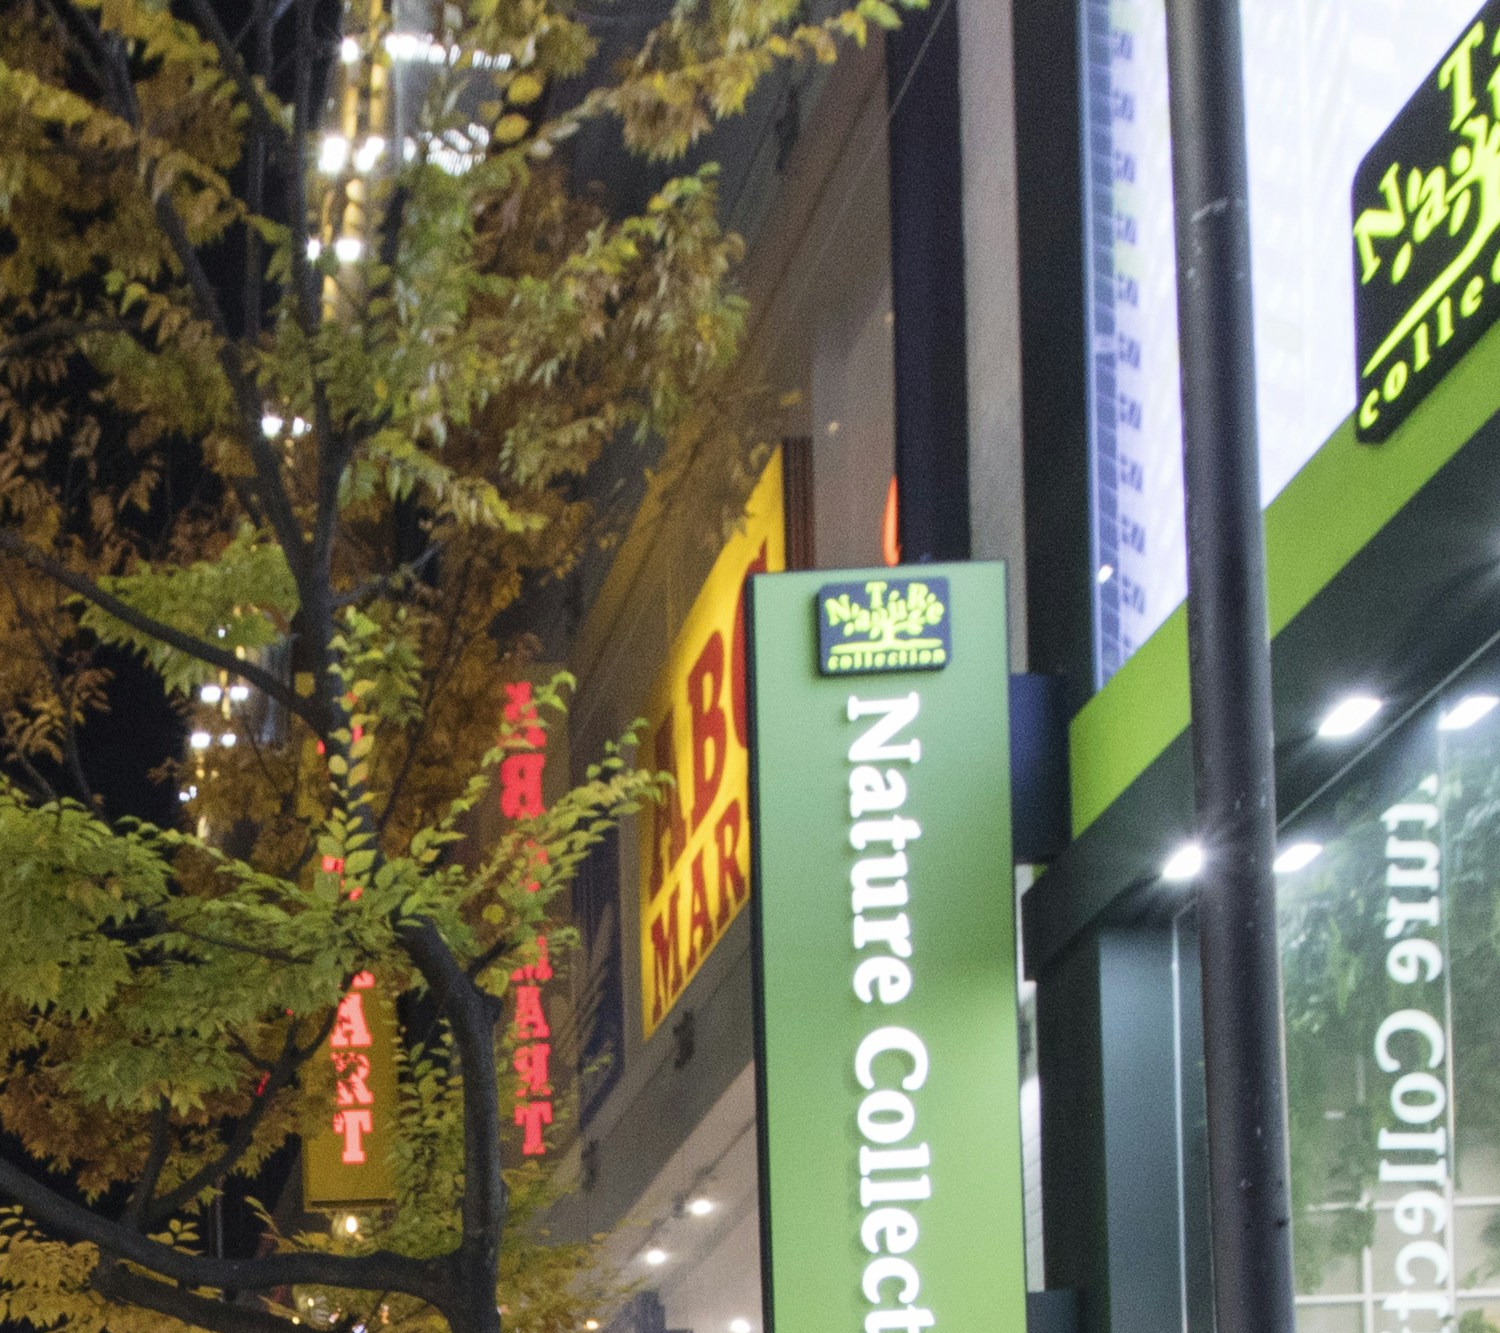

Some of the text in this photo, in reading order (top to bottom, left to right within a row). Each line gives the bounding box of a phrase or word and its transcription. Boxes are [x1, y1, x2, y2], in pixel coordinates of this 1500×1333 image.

[828, 649, 947, 672] collection
[650, 795, 749, 1030] MAR
[847, 691, 921, 1006] Nature
